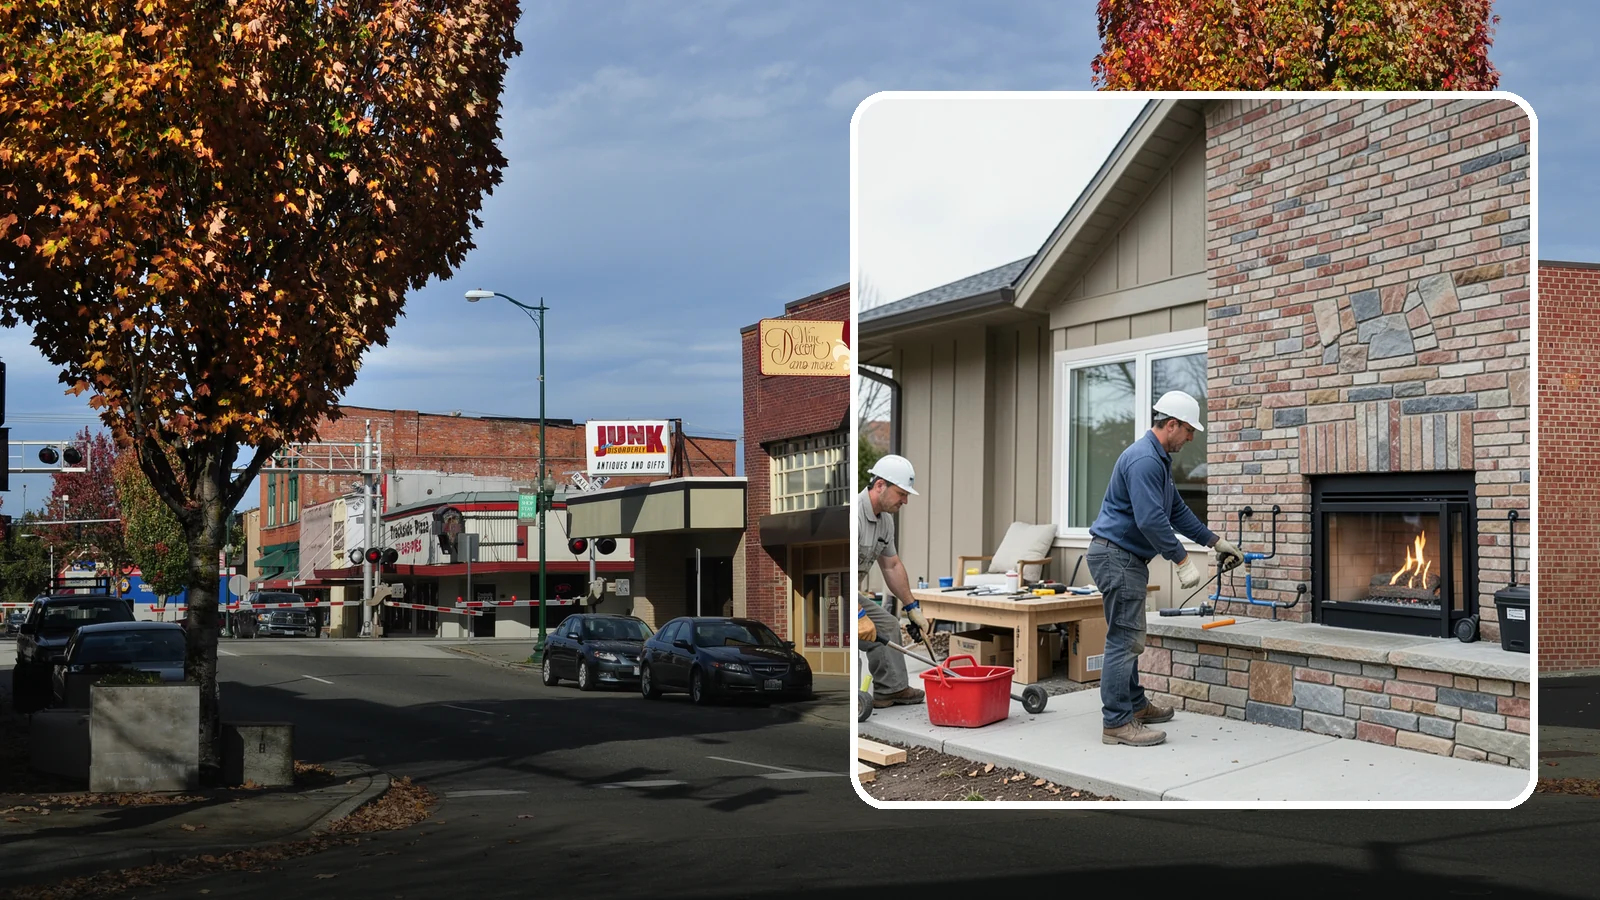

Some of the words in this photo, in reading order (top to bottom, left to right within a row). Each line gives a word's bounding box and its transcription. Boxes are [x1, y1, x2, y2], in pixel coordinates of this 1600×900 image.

[595, 425, 665, 457] JUNK
[597, 461, 628, 470] ANTIQUES
[631, 461, 644, 470] AND
[647, 461, 665, 469] GIFTS
[353, 498, 364, 511] CRO
[390, 521, 412, 539] Trackside
[414, 519, 429, 534] Pizza
